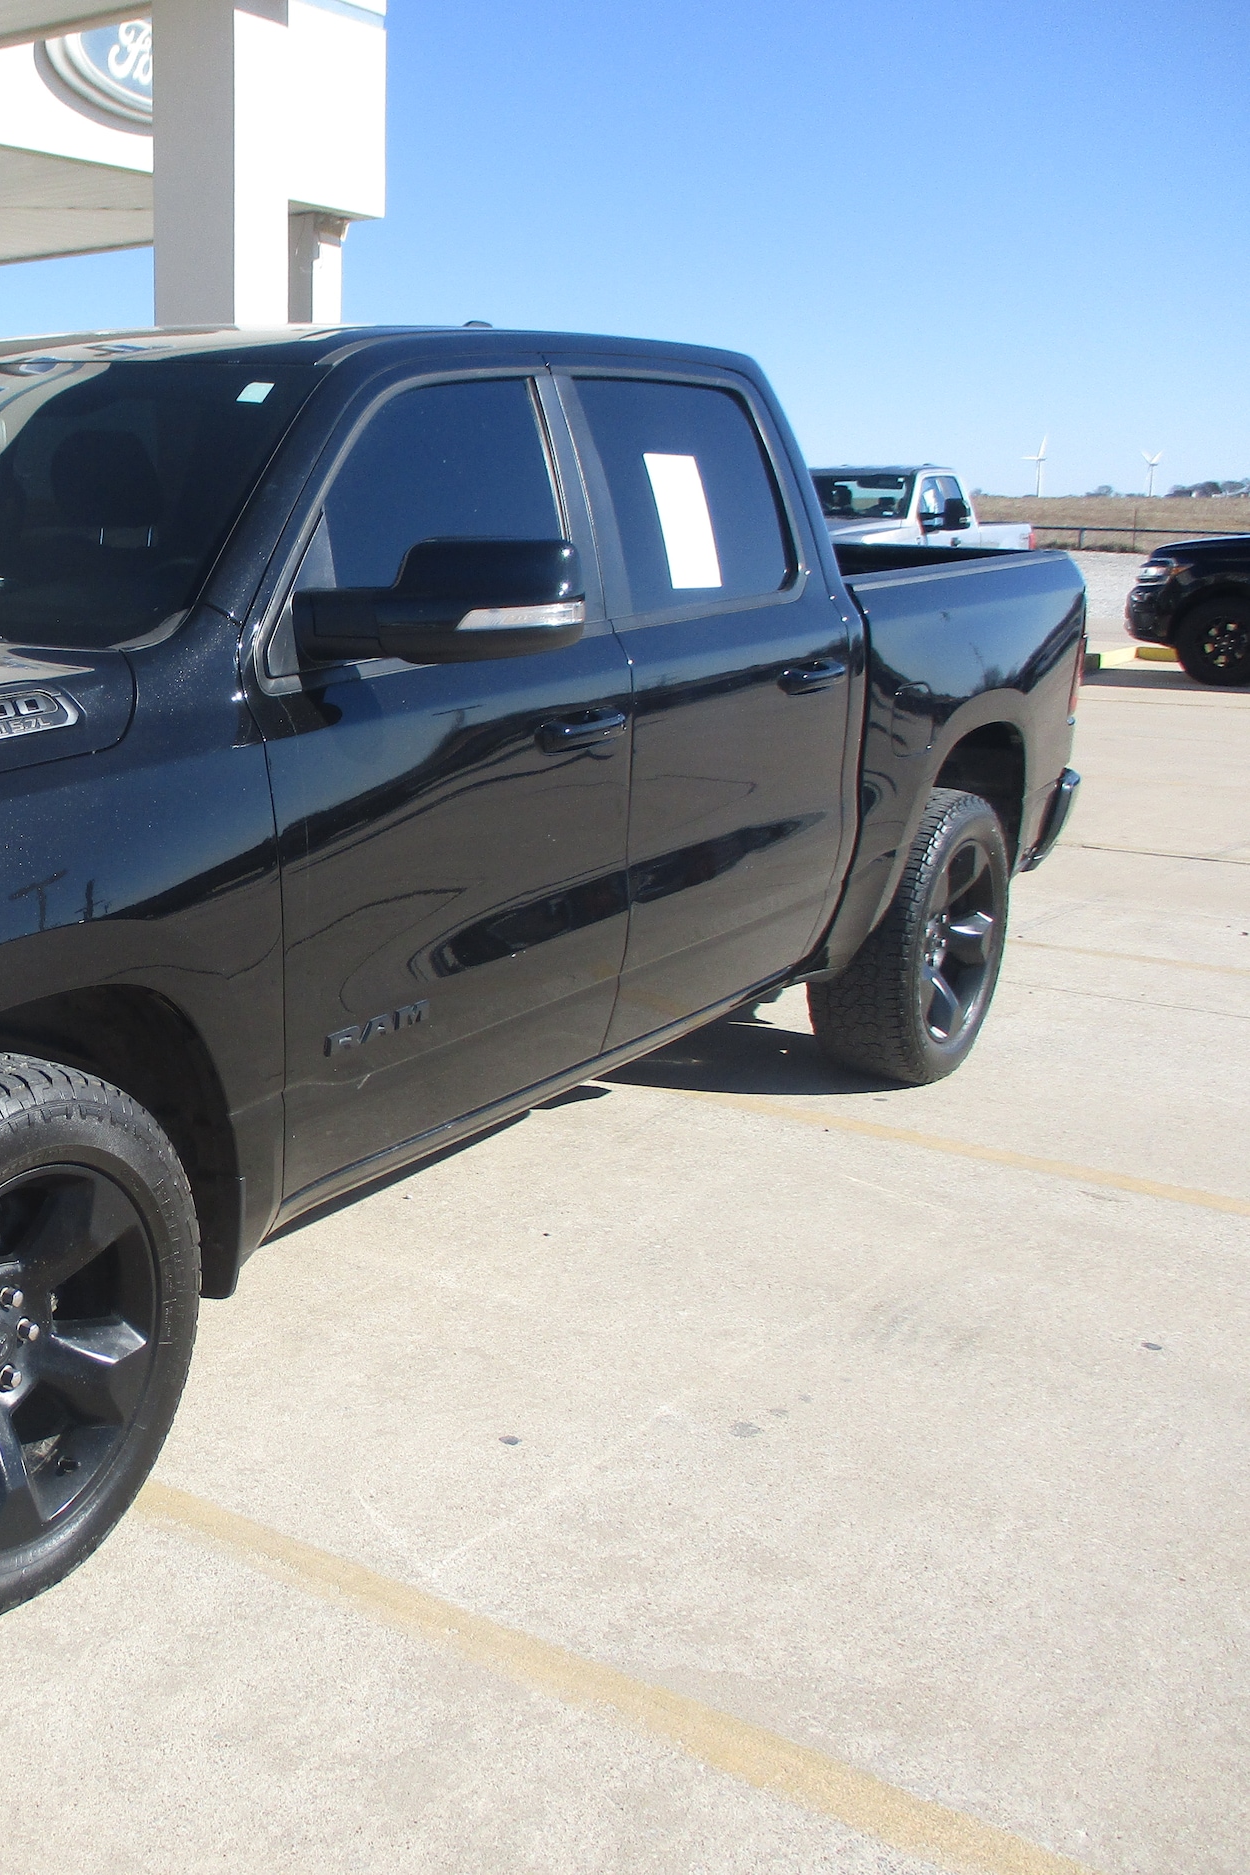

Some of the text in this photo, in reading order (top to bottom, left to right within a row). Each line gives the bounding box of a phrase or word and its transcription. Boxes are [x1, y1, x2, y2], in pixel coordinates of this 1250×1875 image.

[108, 19, 153, 86] Fo
[9, 718, 51, 735] 5.7L
[323, 998, 431, 1058] RAM
